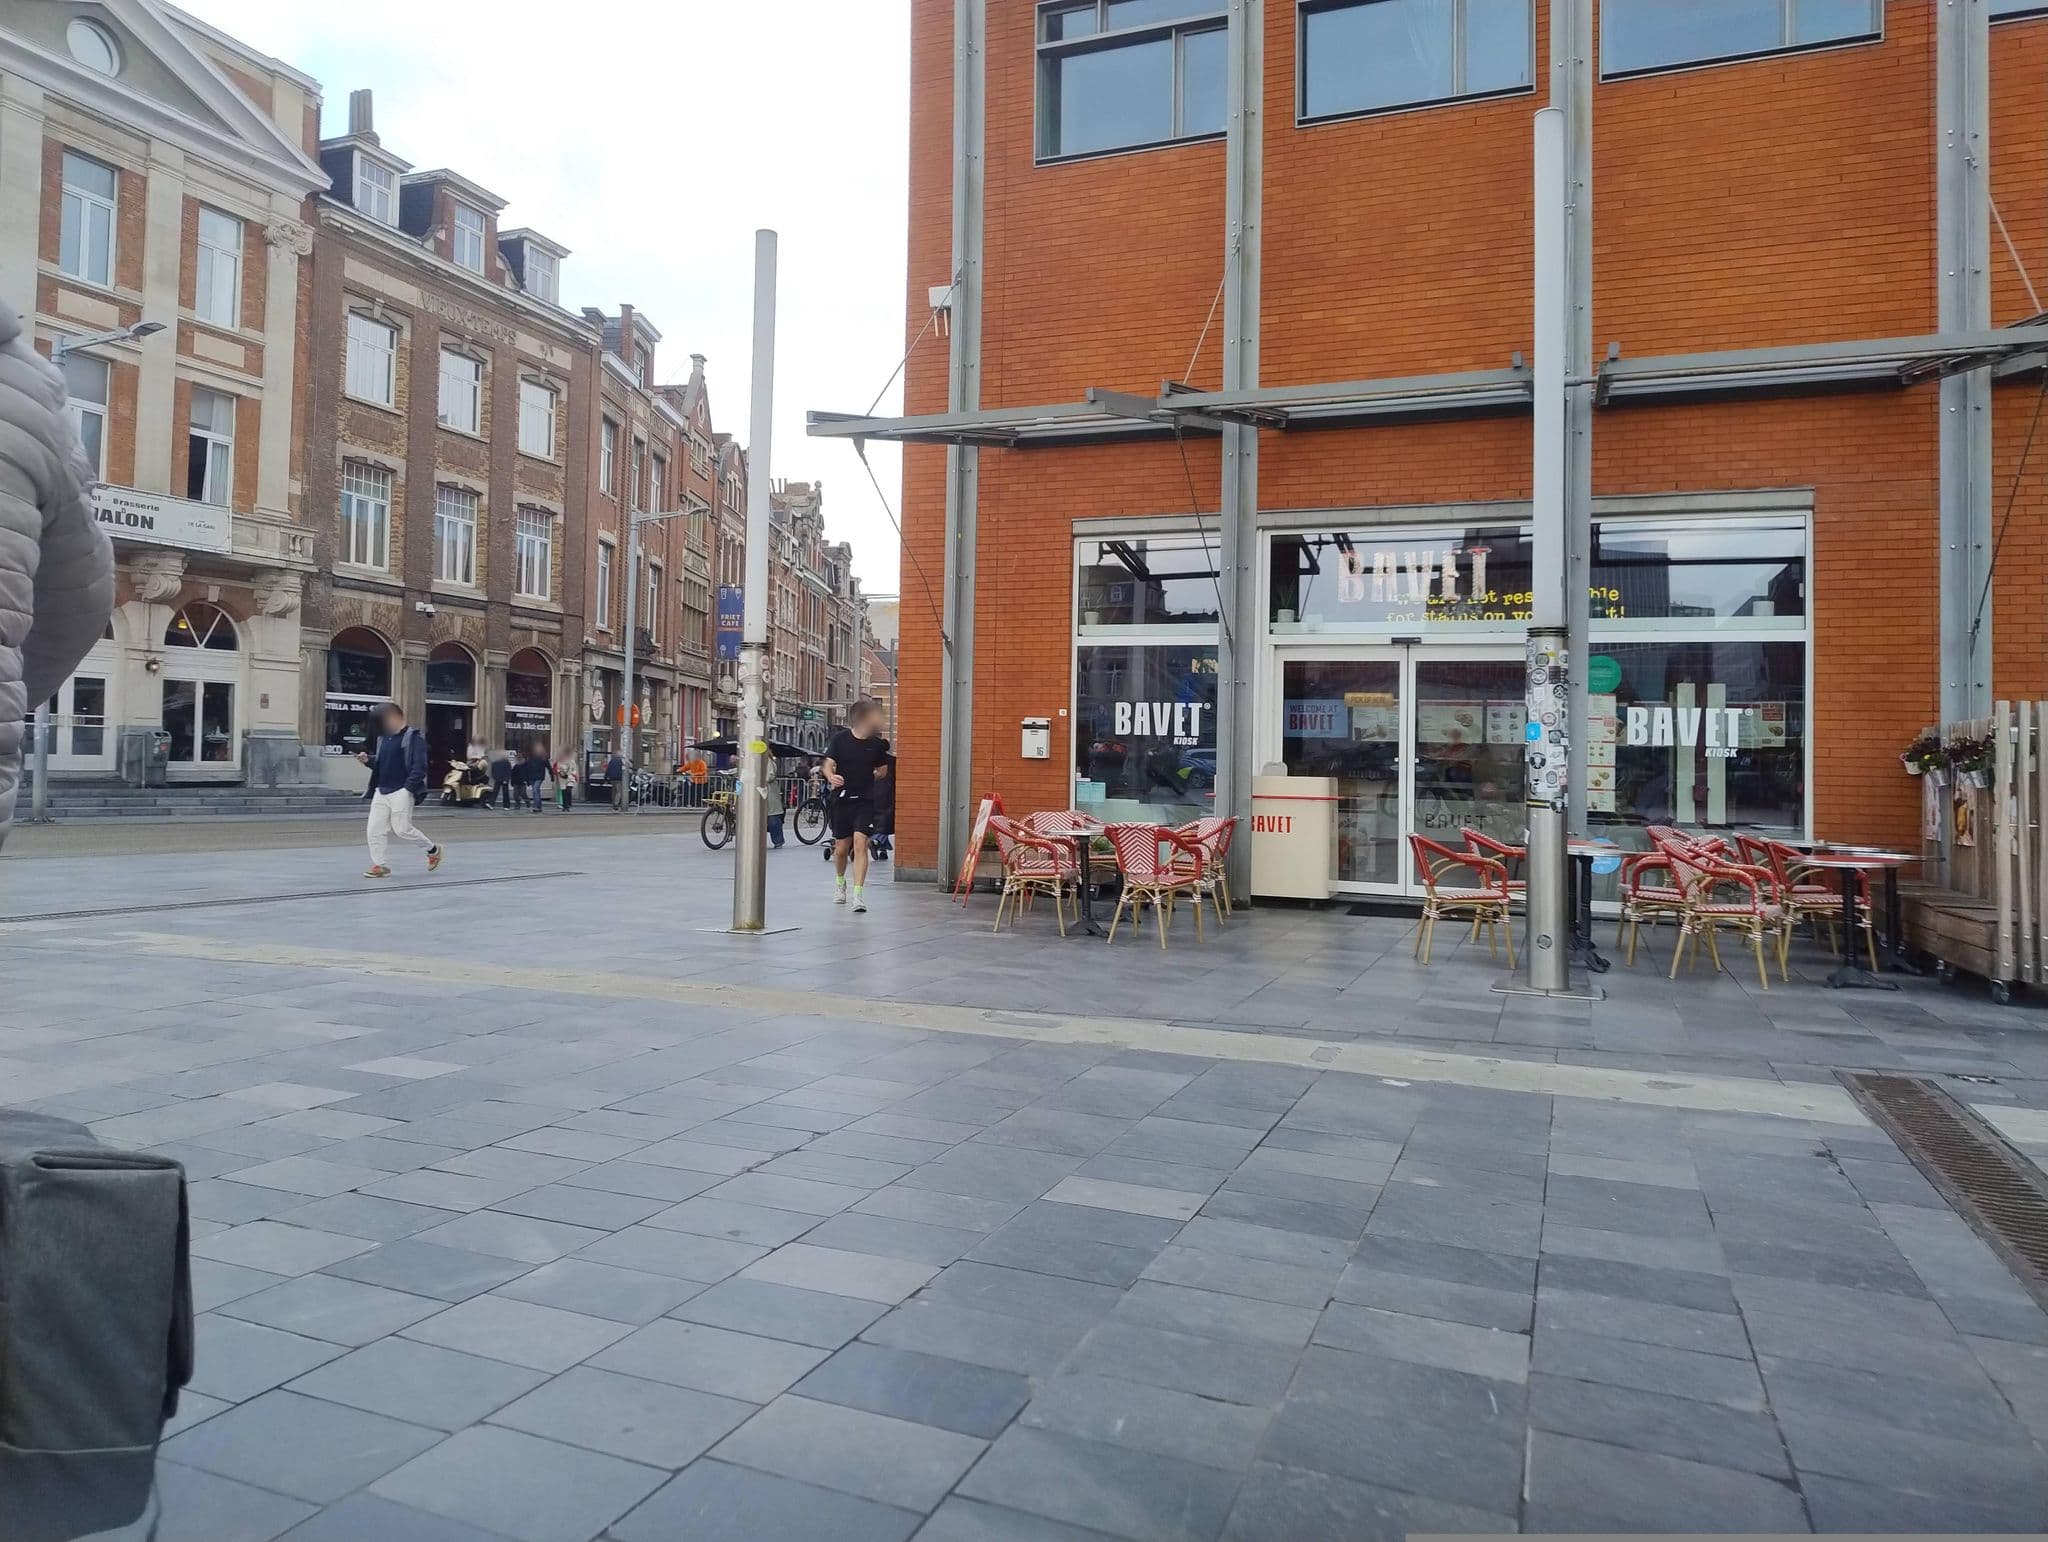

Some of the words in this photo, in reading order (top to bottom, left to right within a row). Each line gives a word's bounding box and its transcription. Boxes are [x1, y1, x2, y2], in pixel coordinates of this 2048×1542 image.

[1337, 546, 1492, 603] BAVET
[1289, 704, 1326, 713] WELCOME
[1328, 704, 1339, 713] AT
[1289, 713, 1335, 730] BAVET
[1173, 737, 1199, 746] KIOSK
[1705, 748, 1739, 758] KIOSK
